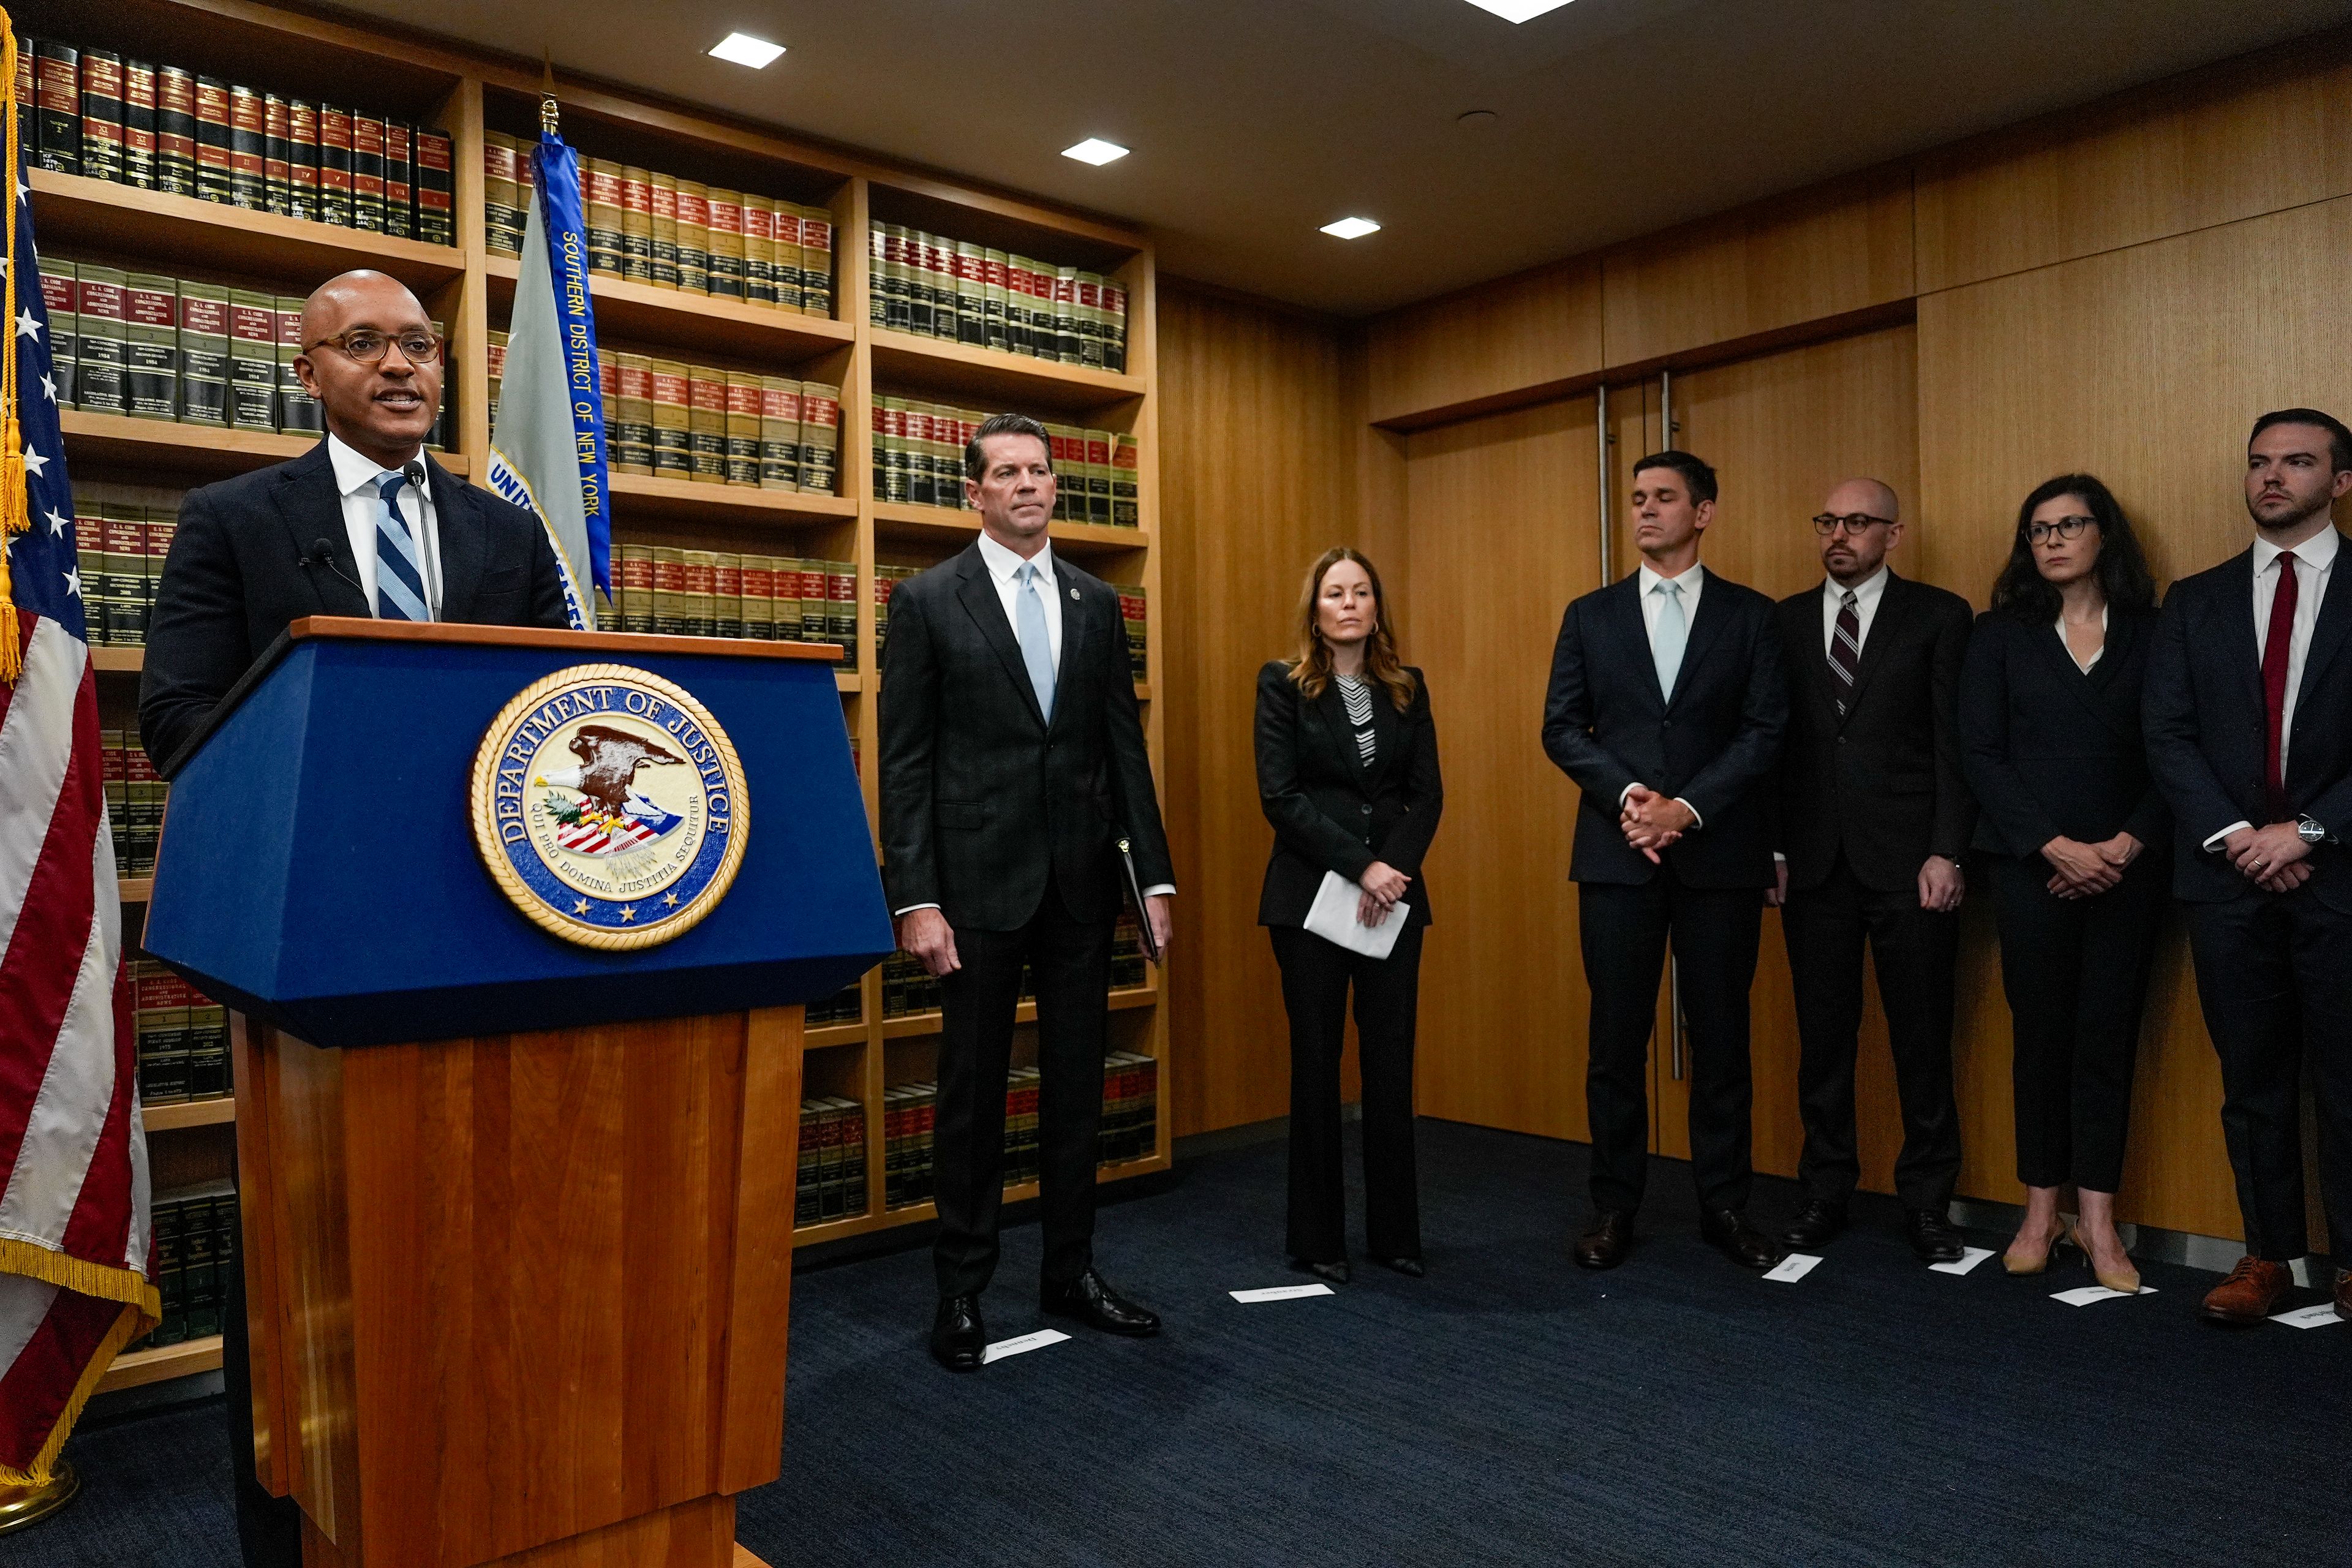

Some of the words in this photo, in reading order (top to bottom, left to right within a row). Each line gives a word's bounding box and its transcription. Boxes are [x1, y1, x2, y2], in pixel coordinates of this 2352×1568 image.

[563, 231, 585, 317] SOUTHERN
[569, 324, 592, 393] DISTRICT
[575, 401, 594, 423] OF
[576, 432, 596, 464] NEW
[491, 463, 533, 510] UNIT
[579, 475, 600, 517] YORK
[499, 687, 613, 846] DEPARTMENT
[625, 692, 666, 720] OF
[668, 714, 729, 834] JUSTICE
[530, 802, 543, 832] QUI
[538, 834, 559, 859] PRO
[561, 861, 612, 892] DOMINA
[619, 863, 677, 893] JUSTITIA
[676, 794, 700, 862] SEQUITUR
[996, 1337, 1037, 1351] Dennehy
